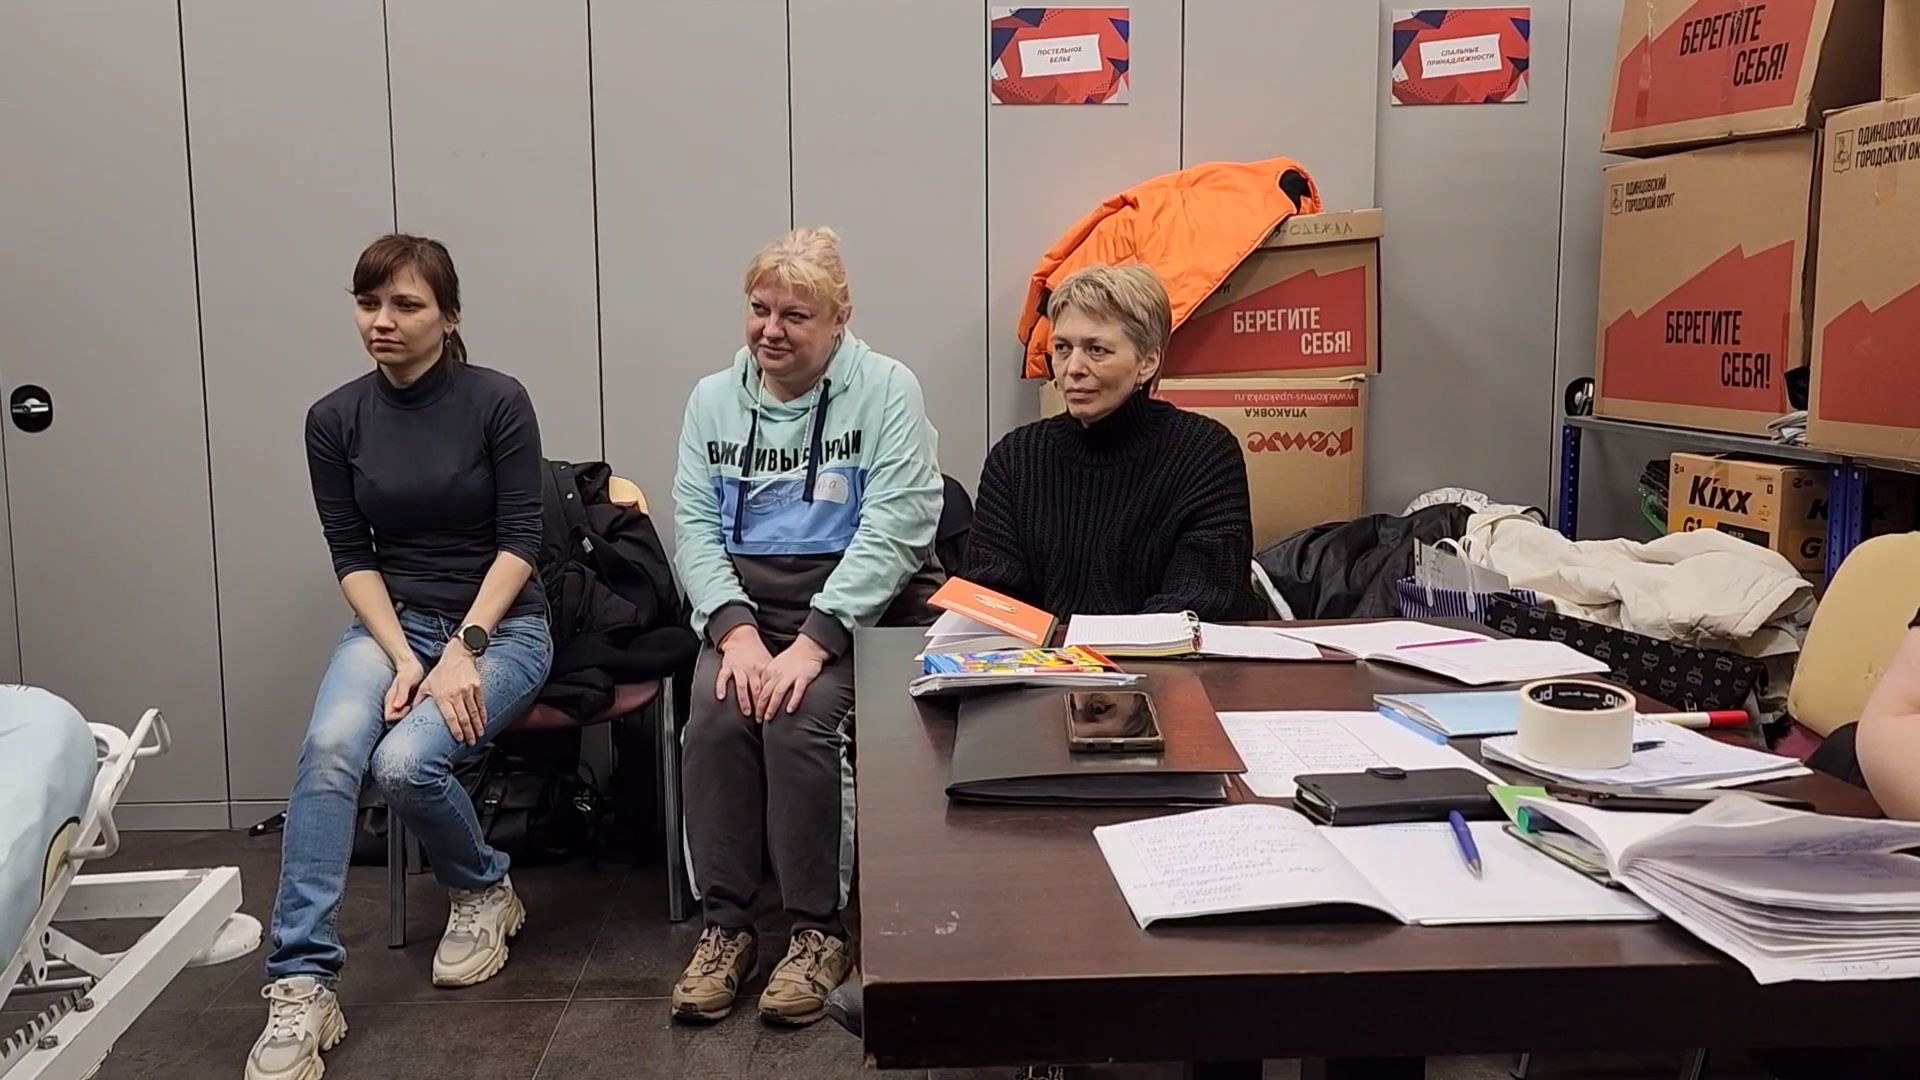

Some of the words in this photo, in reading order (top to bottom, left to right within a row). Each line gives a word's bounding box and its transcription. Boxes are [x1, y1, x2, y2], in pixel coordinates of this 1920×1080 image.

[1679, 4, 1766, 56] БЕРЕГИТЕ
[1037, 46, 1082, 56] ПОСТЕЛЬНОЕ
[1049, 56, 1072, 64] БЕЛЬЕ
[1426, 53, 1495, 66] ПРИНАДЛЕЖНОСТИ
[1441, 46, 1479, 57] СПАЛЬНЫЕ
[1733, 41, 1790, 87] СЕБЯ!
[1858, 116, 1920, 146] ОДИНЦОВСКИ
[1855, 139, 1908, 168] ГОРОДСКОЙ
[1233, 307, 1321, 334] БЕРЕГИТЕ
[1665, 311, 1743, 345] БЕРЕГИТЕ
[1301, 330, 1352, 355] СЕБЯ!
[1721, 353, 1771, 389] СЕБЯ!
[1245, 408, 1308, 417] УПАКОВКА
[1688, 475, 1752, 515] Kixx
